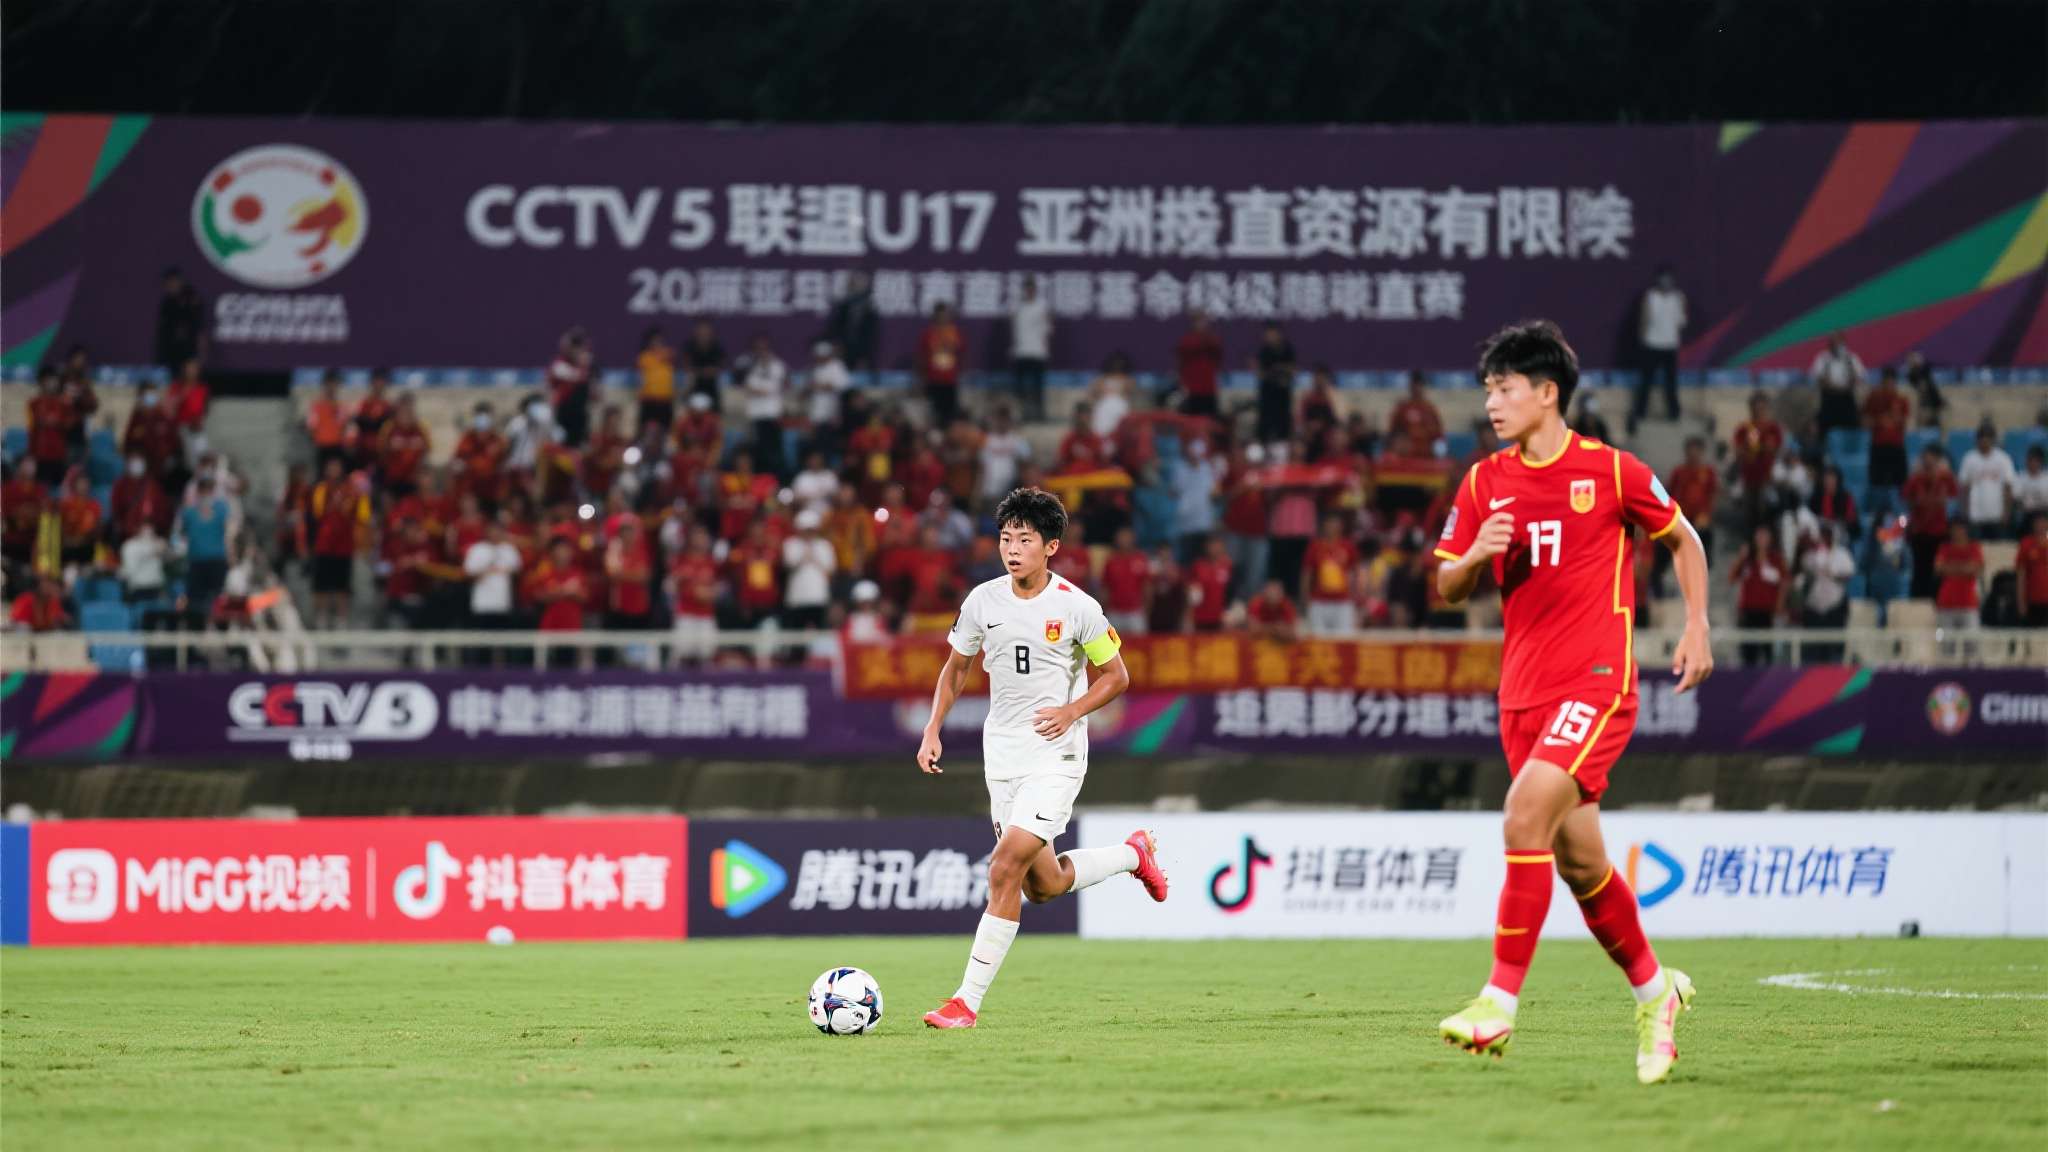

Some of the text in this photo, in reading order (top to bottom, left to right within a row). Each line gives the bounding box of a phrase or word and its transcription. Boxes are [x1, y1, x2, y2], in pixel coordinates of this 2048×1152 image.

[466, 185, 661, 248] CCTV
[669, 189, 715, 249] 5
[1015, 645, 1030, 674] 8
[1550, 700, 1598, 744] 15
[466, 853, 671, 911] 抖音体育
[1284, 846, 1462, 891] 抖音体育
[1693, 845, 1895, 897] 腾讯体育
